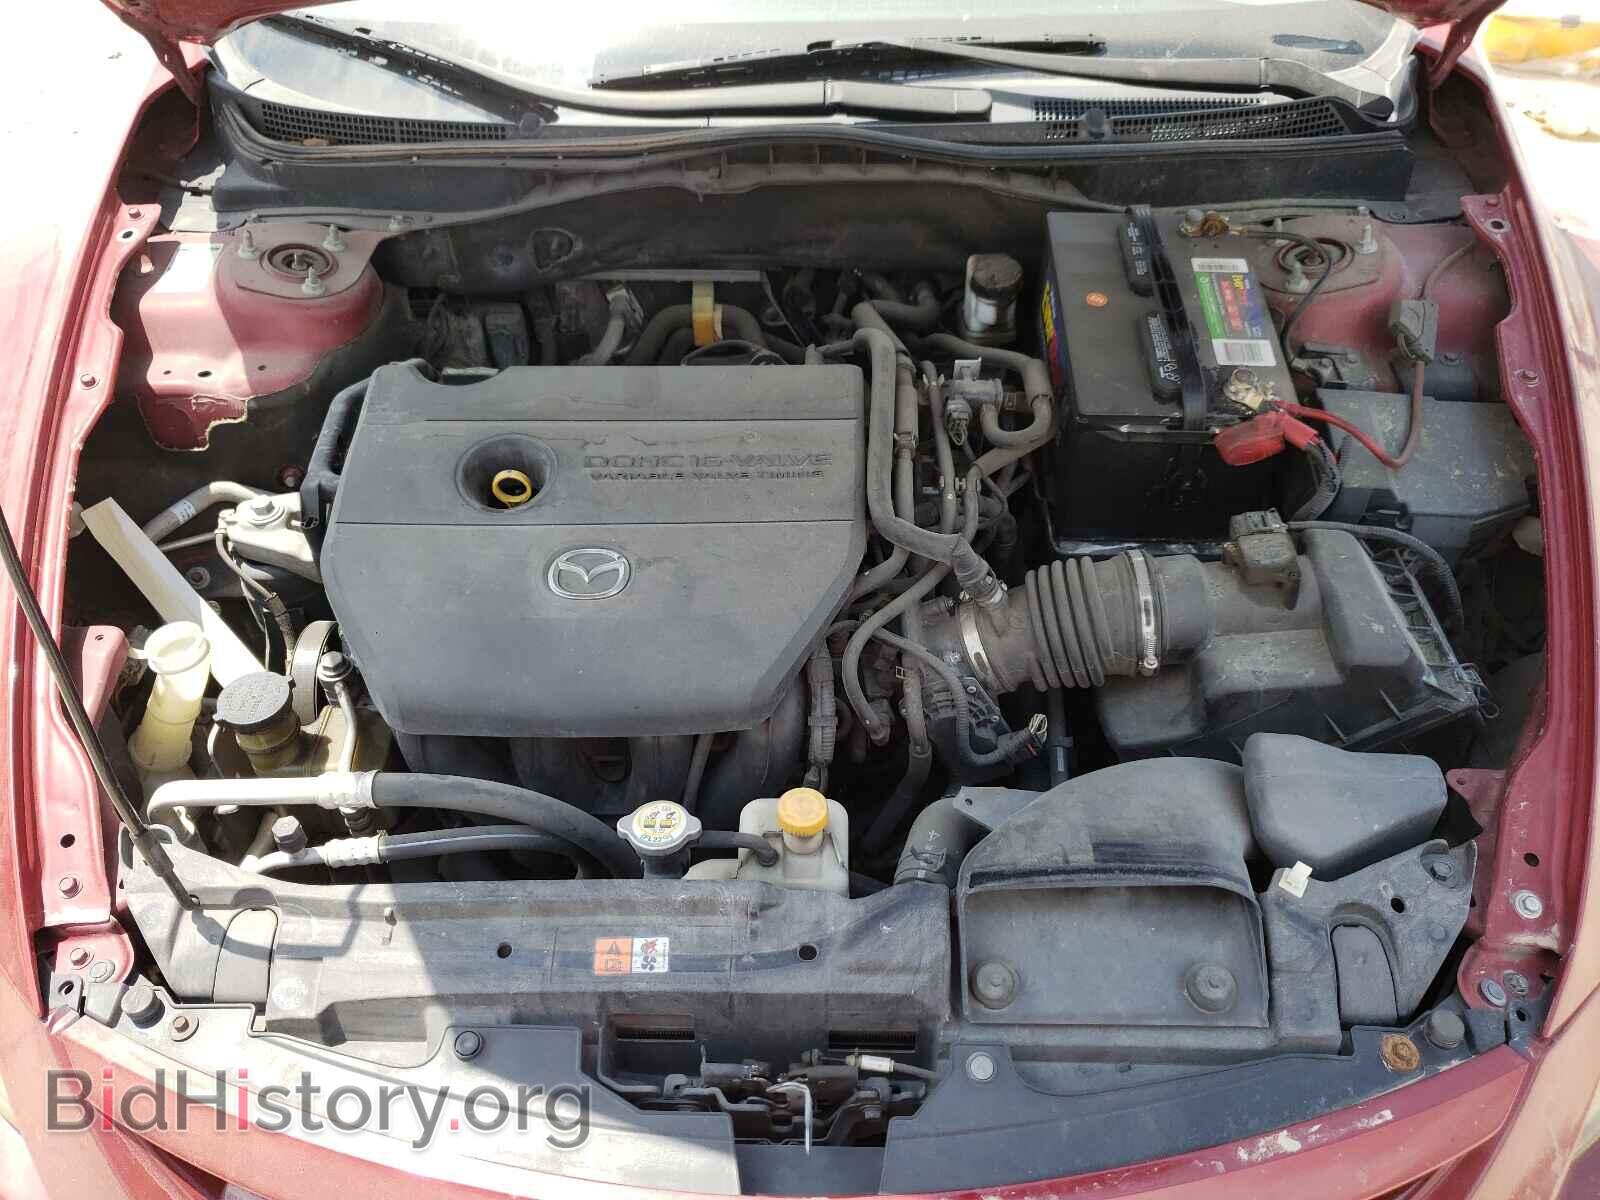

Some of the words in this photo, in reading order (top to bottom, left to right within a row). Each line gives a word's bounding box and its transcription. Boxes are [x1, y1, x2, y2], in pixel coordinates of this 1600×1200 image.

[583, 455, 684, 468] DOHC
[590, 471, 686, 481] VARIABLE
[692, 471, 752, 481] VALVE
